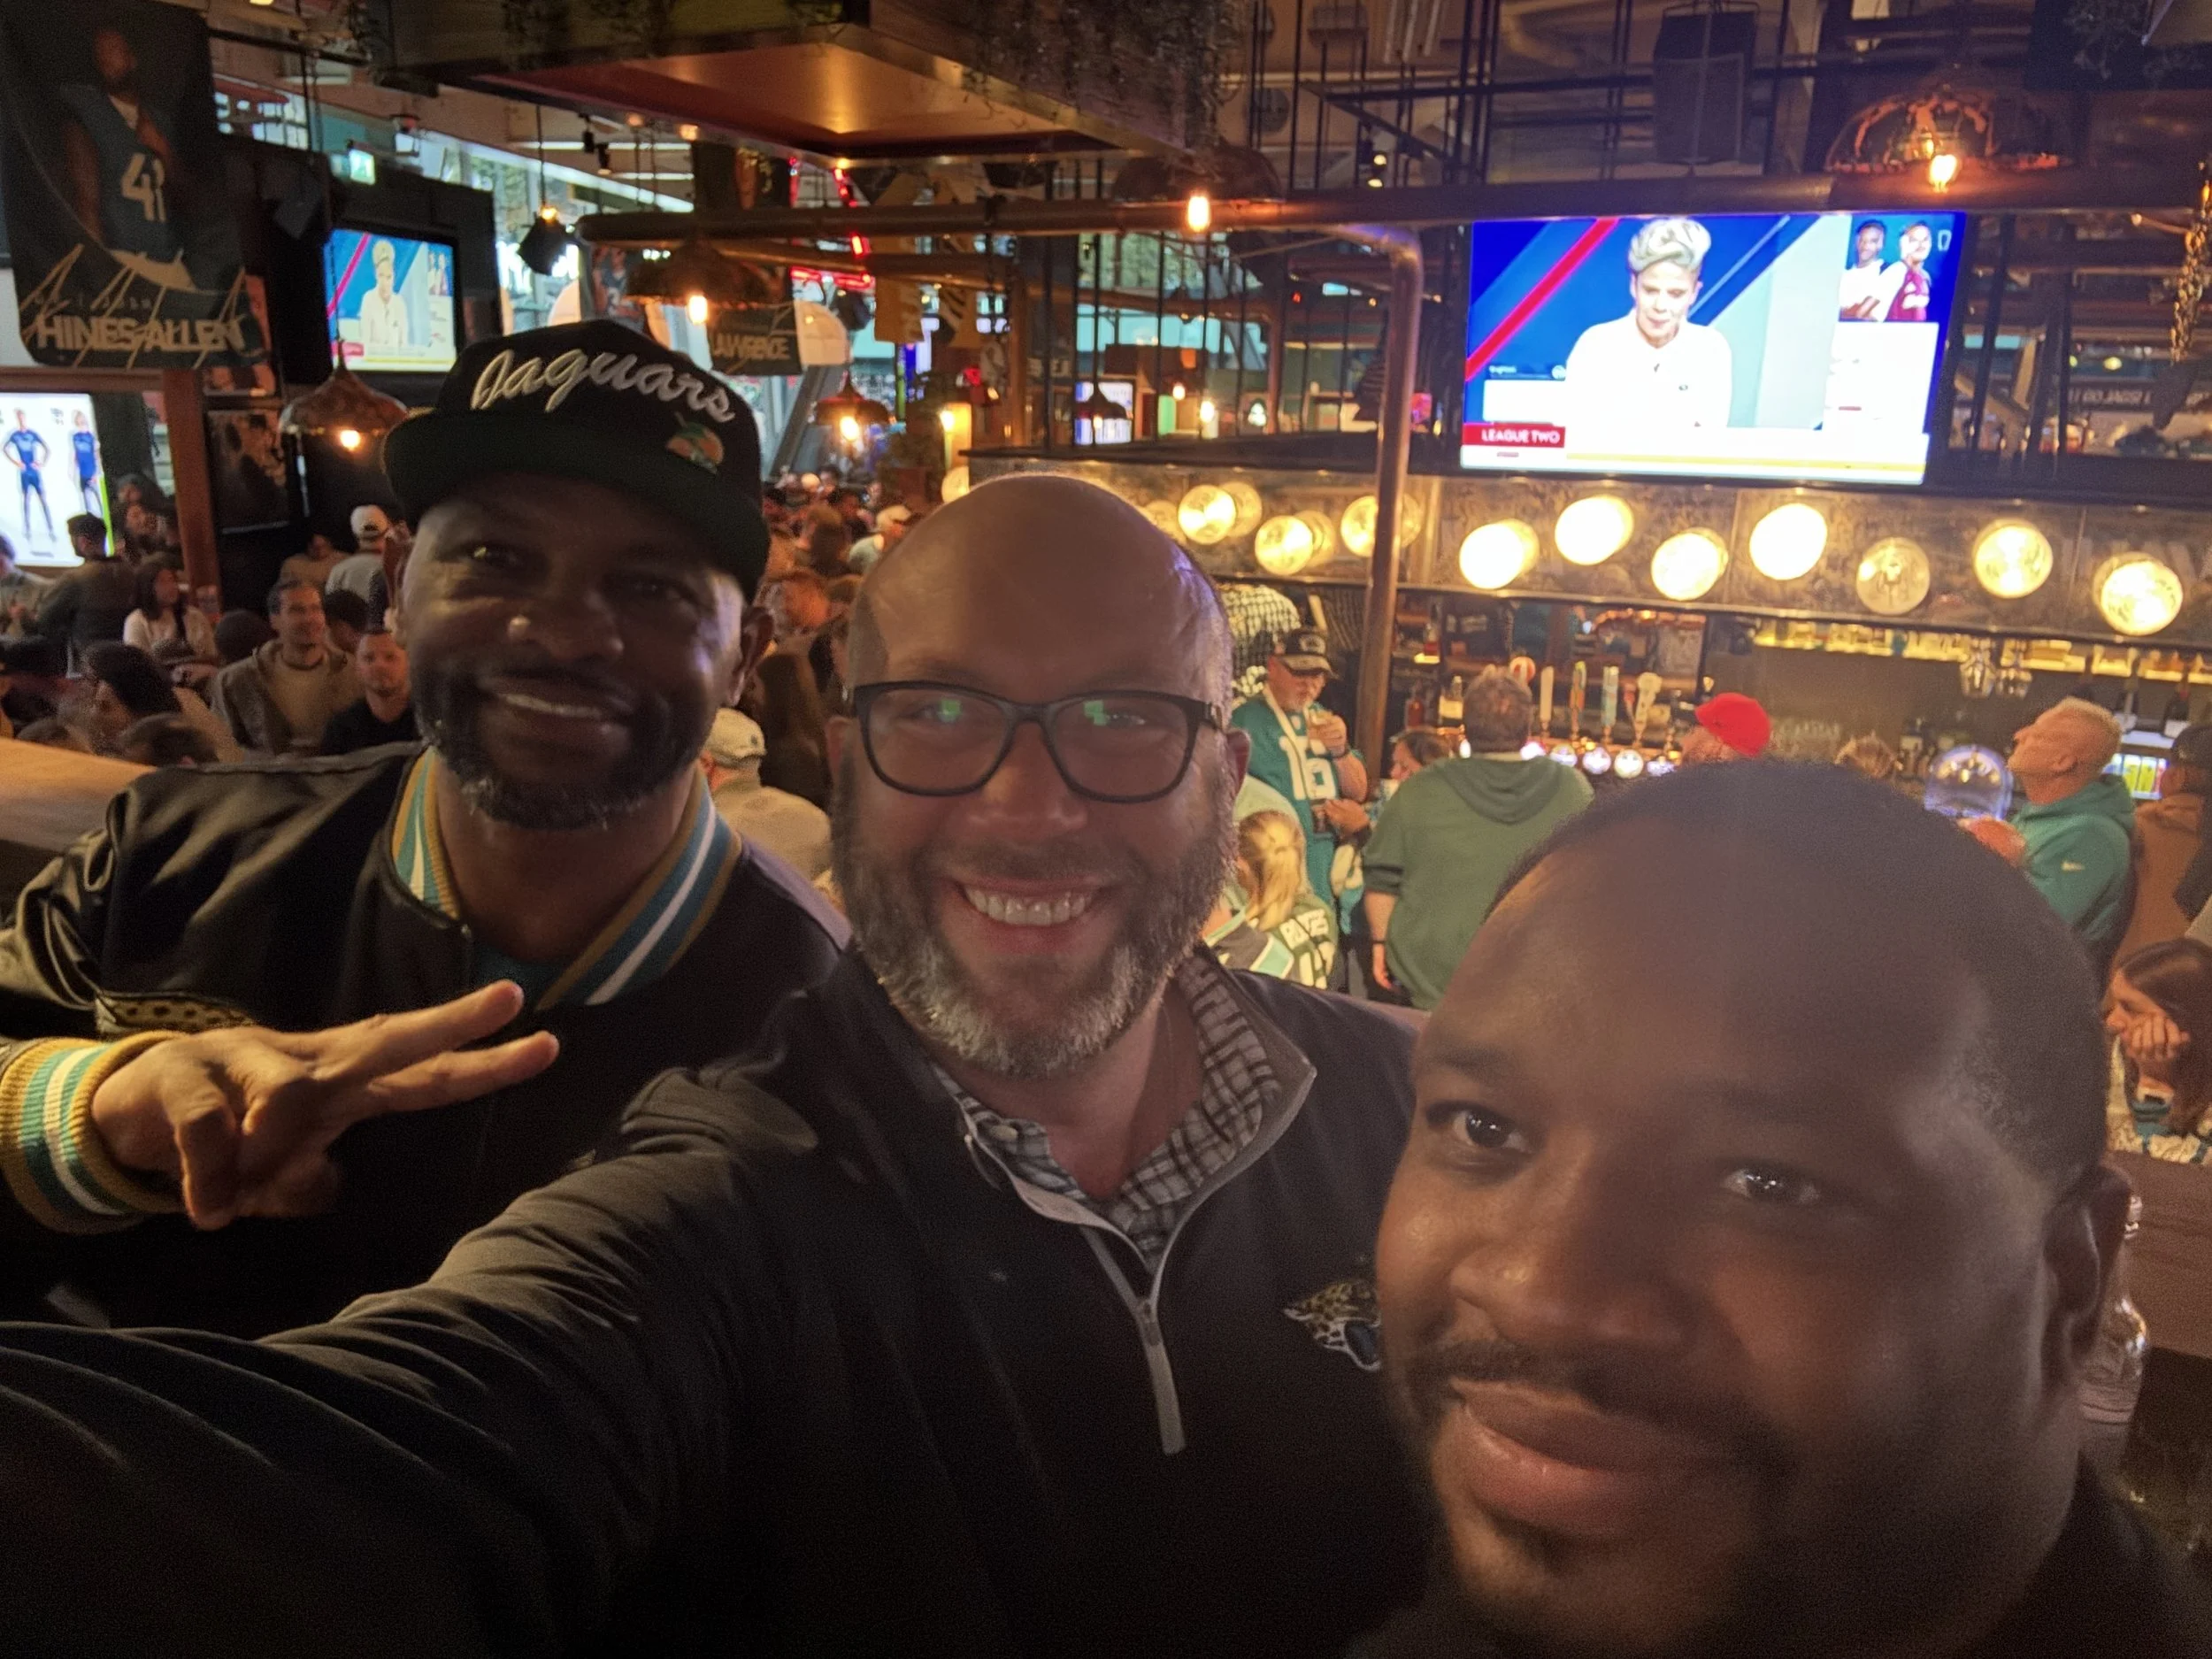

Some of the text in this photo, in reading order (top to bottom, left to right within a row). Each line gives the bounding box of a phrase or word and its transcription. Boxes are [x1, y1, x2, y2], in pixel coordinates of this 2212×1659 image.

[120, 152, 167, 222] 41
[470, 349, 735, 423] Jaguars
[1481, 429, 1561, 443] LEAGUE TWO
